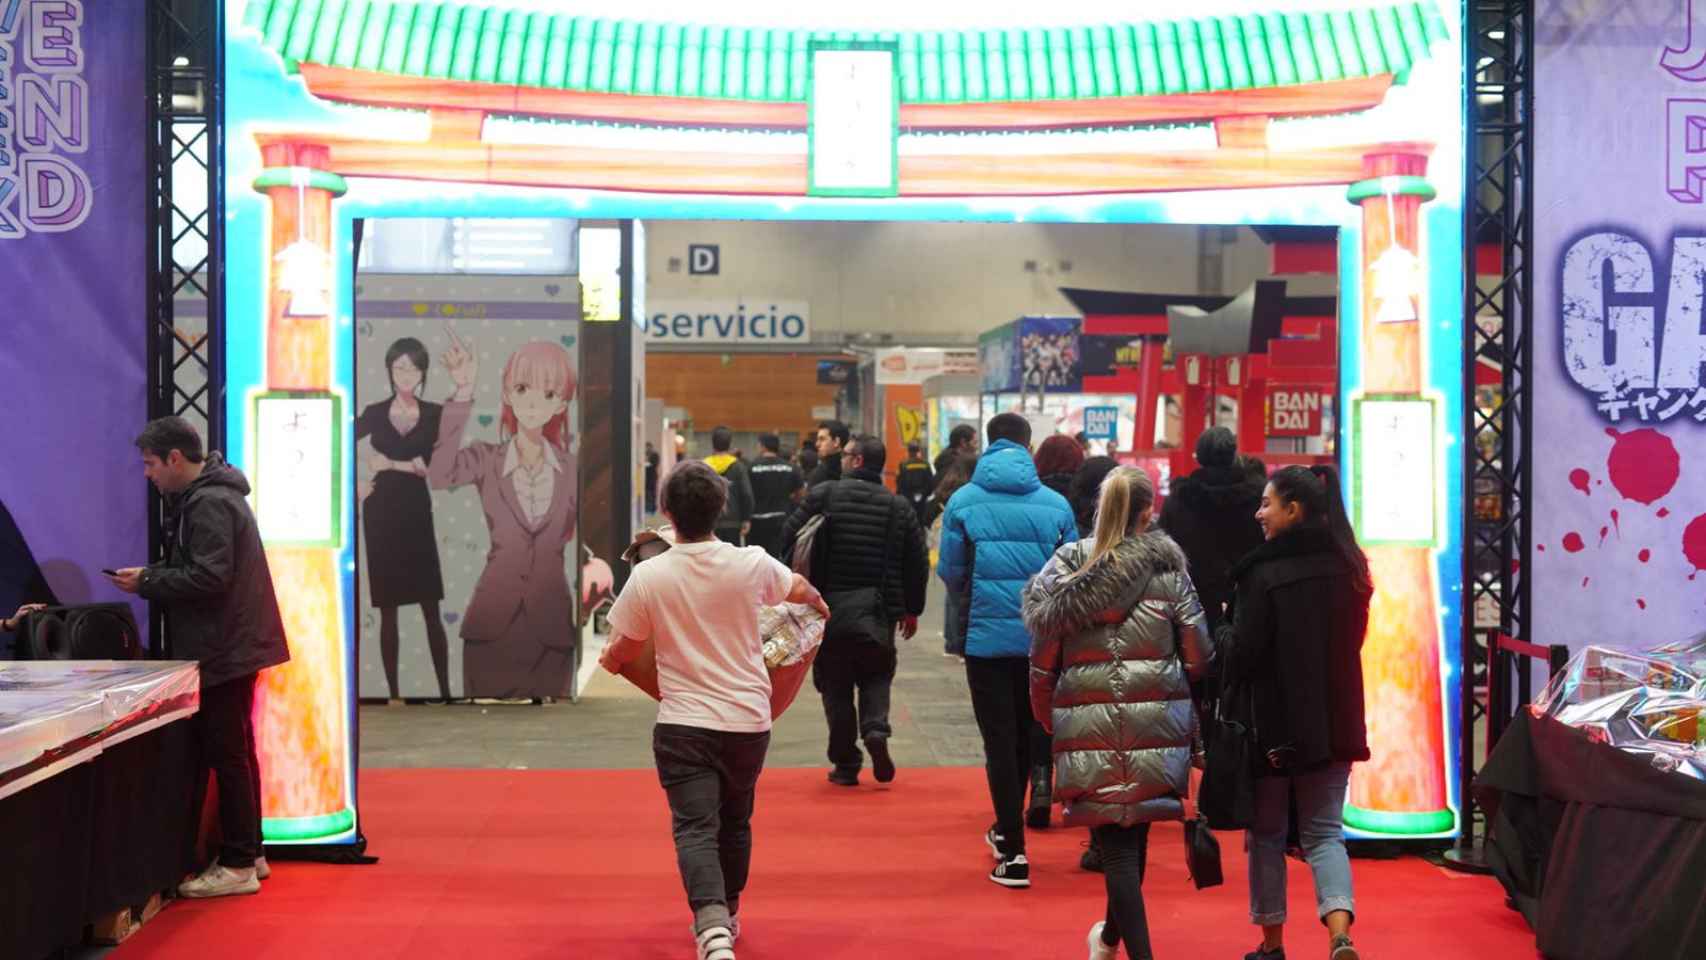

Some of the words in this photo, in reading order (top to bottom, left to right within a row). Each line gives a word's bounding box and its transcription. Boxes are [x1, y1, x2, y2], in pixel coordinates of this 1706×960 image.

[693, 247, 714, 273] D
[645, 305, 805, 338] servicio
[1274, 392, 1318, 410] BAN
[1086, 409, 1116, 422] BAN
[1274, 411, 1309, 429] DAI
[1086, 422, 1110, 434] DAI
